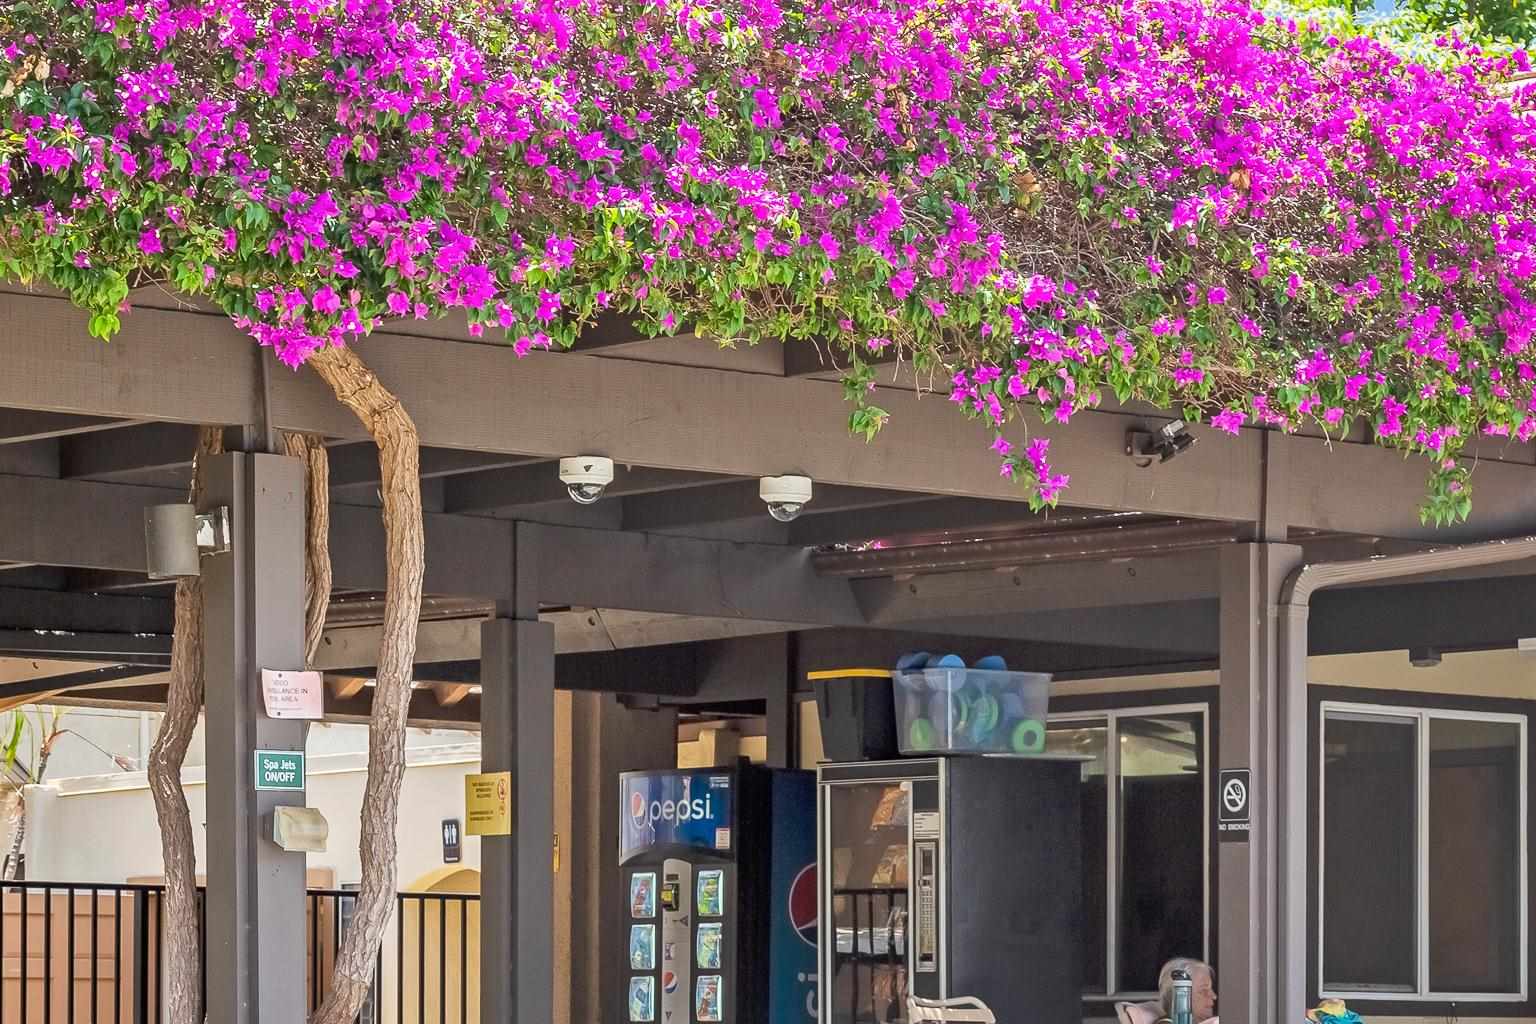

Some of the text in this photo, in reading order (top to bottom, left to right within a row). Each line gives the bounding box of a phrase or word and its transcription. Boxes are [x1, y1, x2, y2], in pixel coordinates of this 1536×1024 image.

[263, 759, 297, 771] Spa Jets
[264, 771, 296, 783] ON/OFF
[649, 793, 711, 827] pepsi
